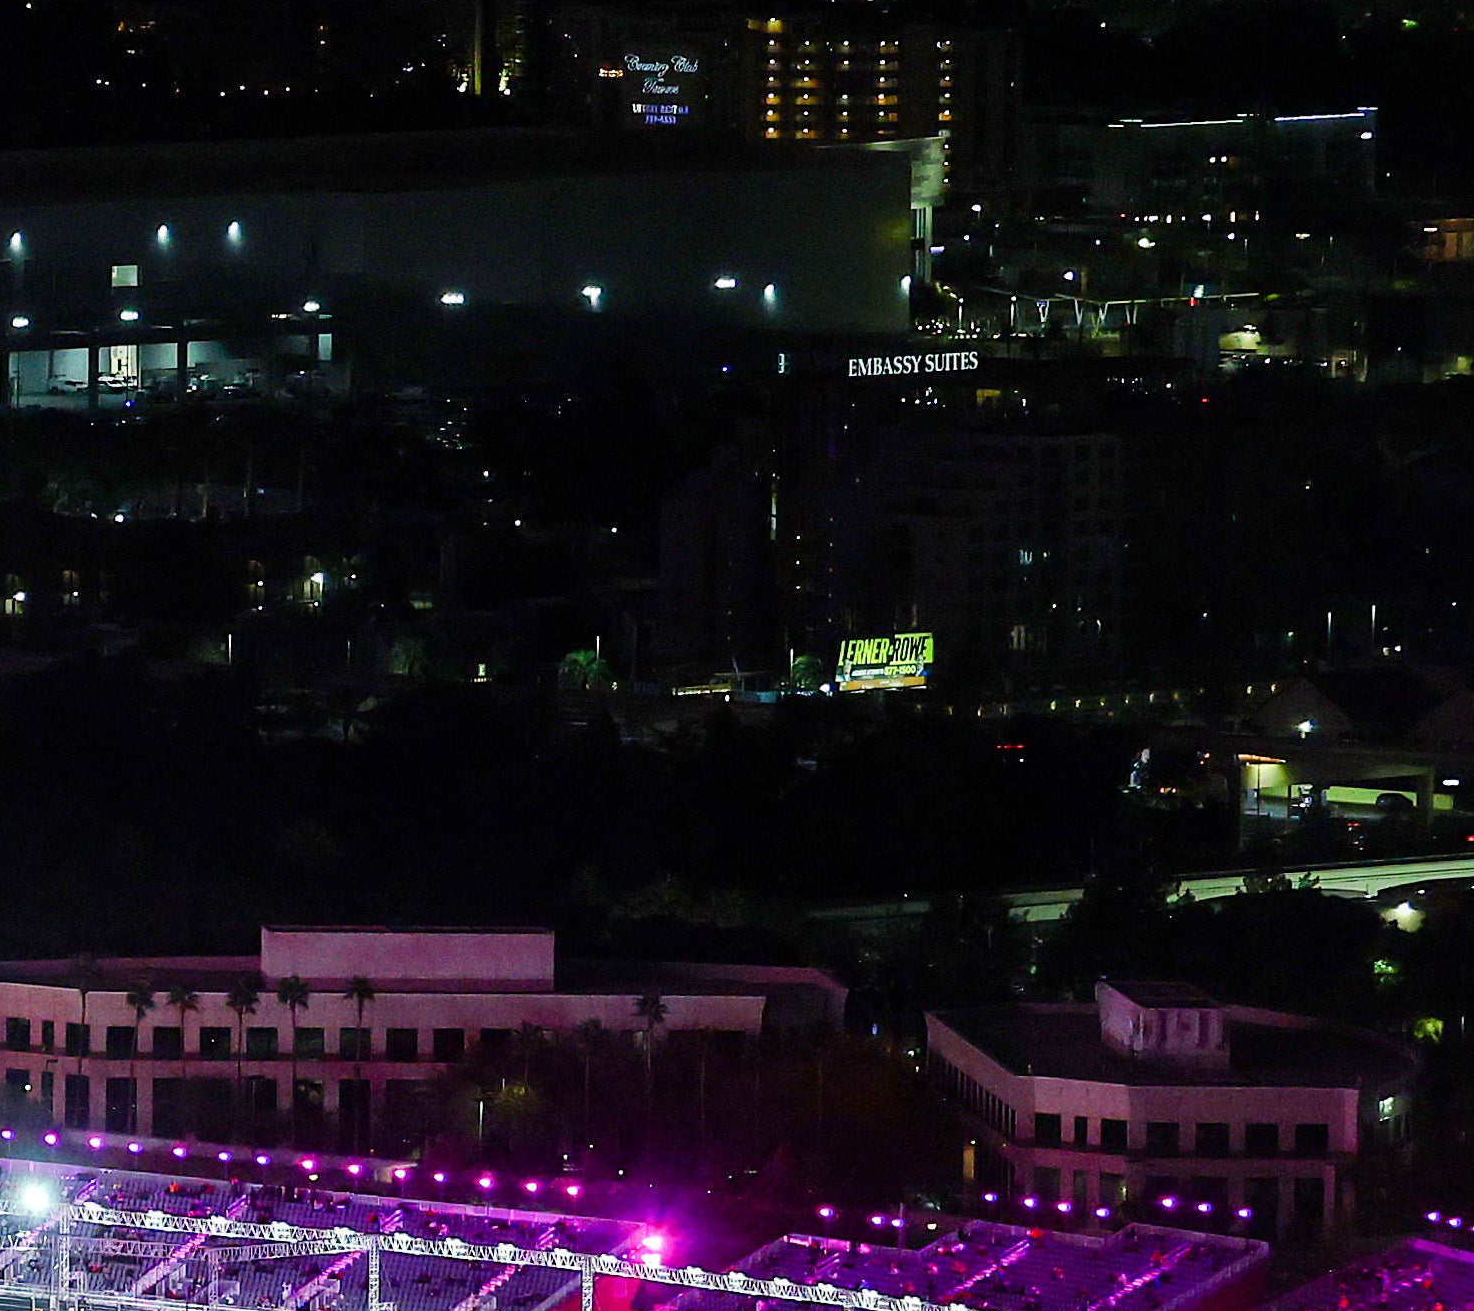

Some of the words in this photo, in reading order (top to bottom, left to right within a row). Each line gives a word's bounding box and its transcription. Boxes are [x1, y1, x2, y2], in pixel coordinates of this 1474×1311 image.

[848, 355, 922, 377] EMBASSY
[925, 351, 978, 372] SUITES
[838, 638, 890, 666] LERNER
